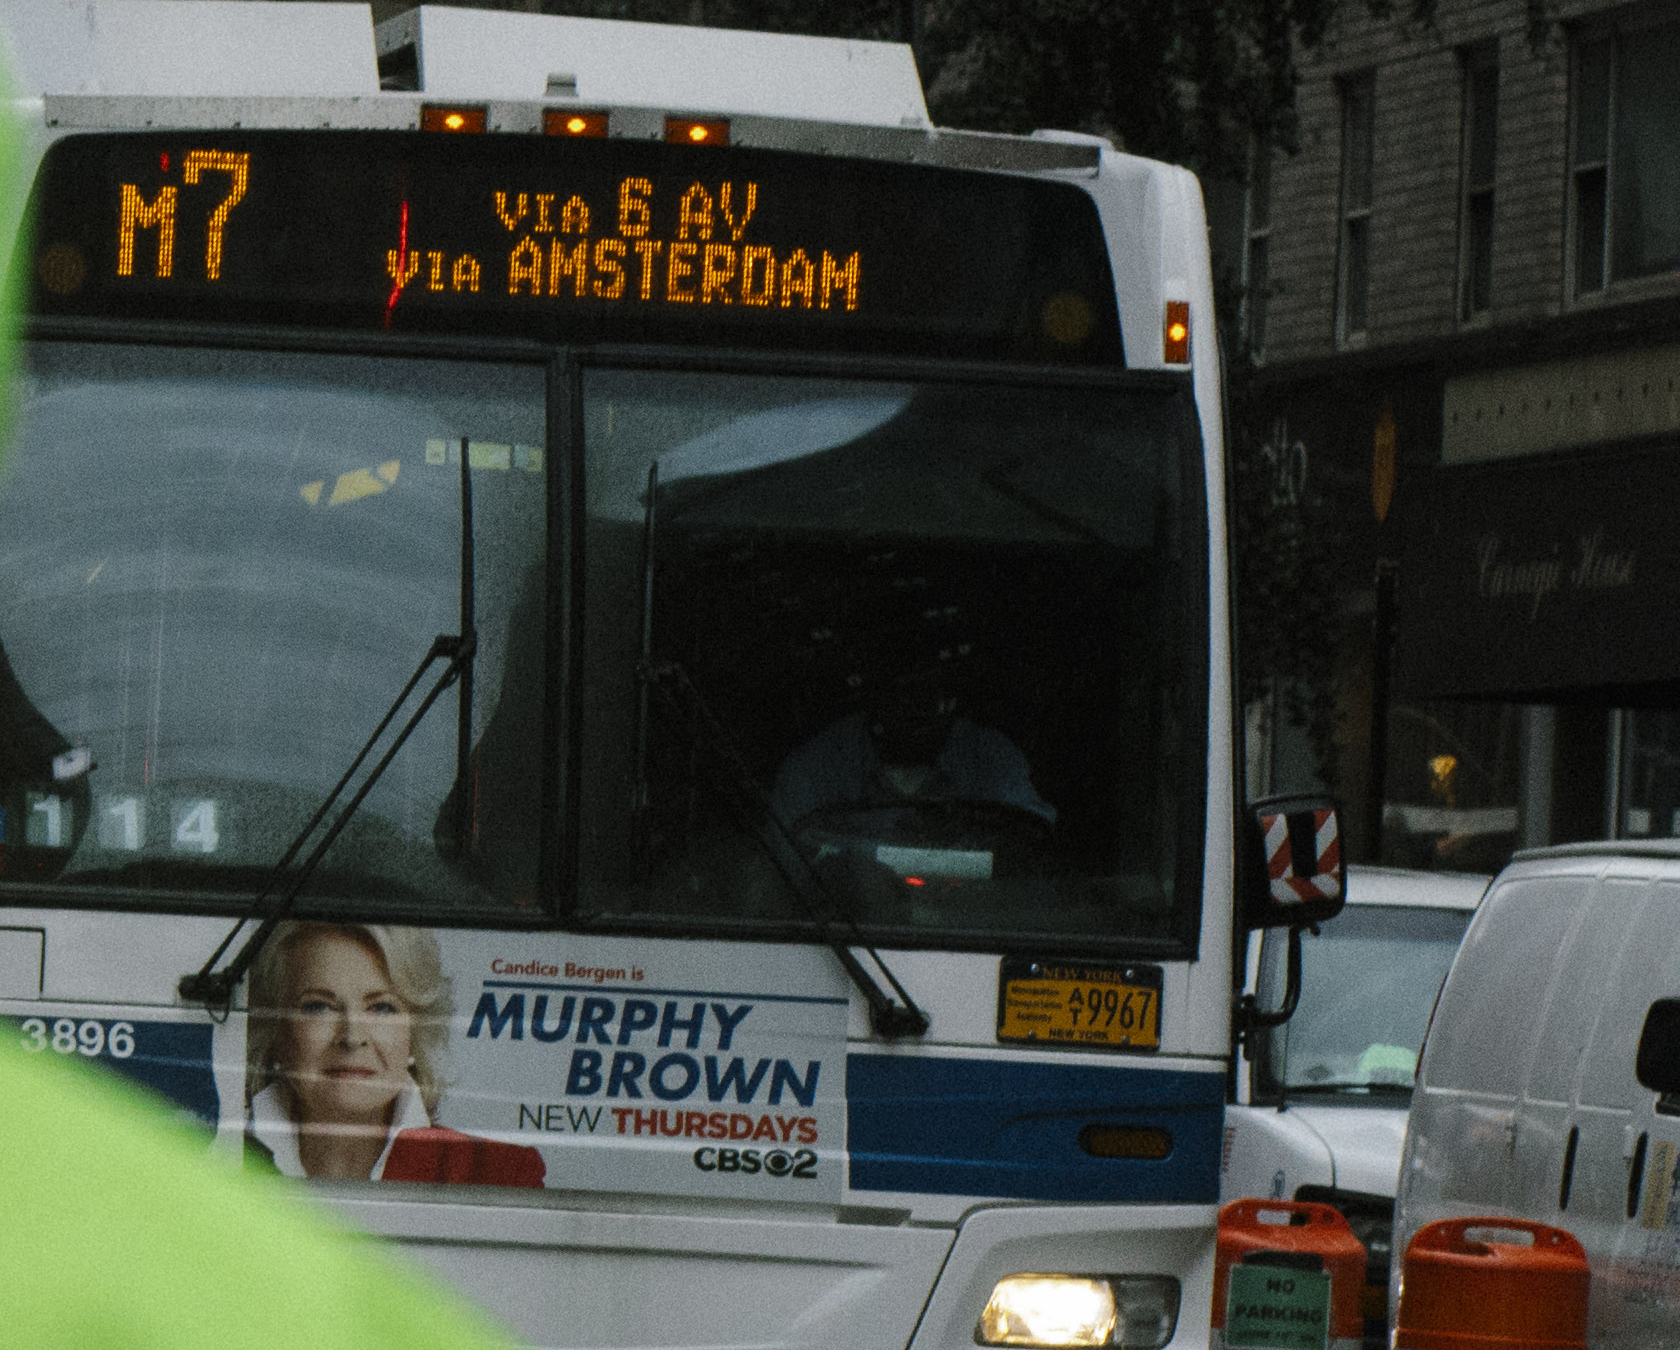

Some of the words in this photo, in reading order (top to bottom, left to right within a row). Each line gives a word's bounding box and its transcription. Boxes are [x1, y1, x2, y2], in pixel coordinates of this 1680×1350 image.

[117, 150, 250, 280] M7
[495, 191, 590, 235] VIA
[618, 177, 652, 238] 6
[679, 180, 758, 241] AV
[509, 235, 861, 311] AMSTERDAM
[491, 958, 559, 977] Candice
[564, 961, 626, 984] Bergen
[631, 965, 645, 982] is
[1084, 969, 1122, 985] YORK
[466, 992, 754, 1051] MURPHY
[1087, 988, 1153, 1030] 9967
[20, 1018, 136, 1059] 3896
[1048, 1028, 1075, 1040] NEW
[565, 1048, 822, 1108] BROWN
[518, 1103, 603, 1133] NEW
[611, 1107, 819, 1144] THURSDAYS
[1266, 1277, 1296, 1295] NO
[1234, 1304, 1323, 1327] PARKING
